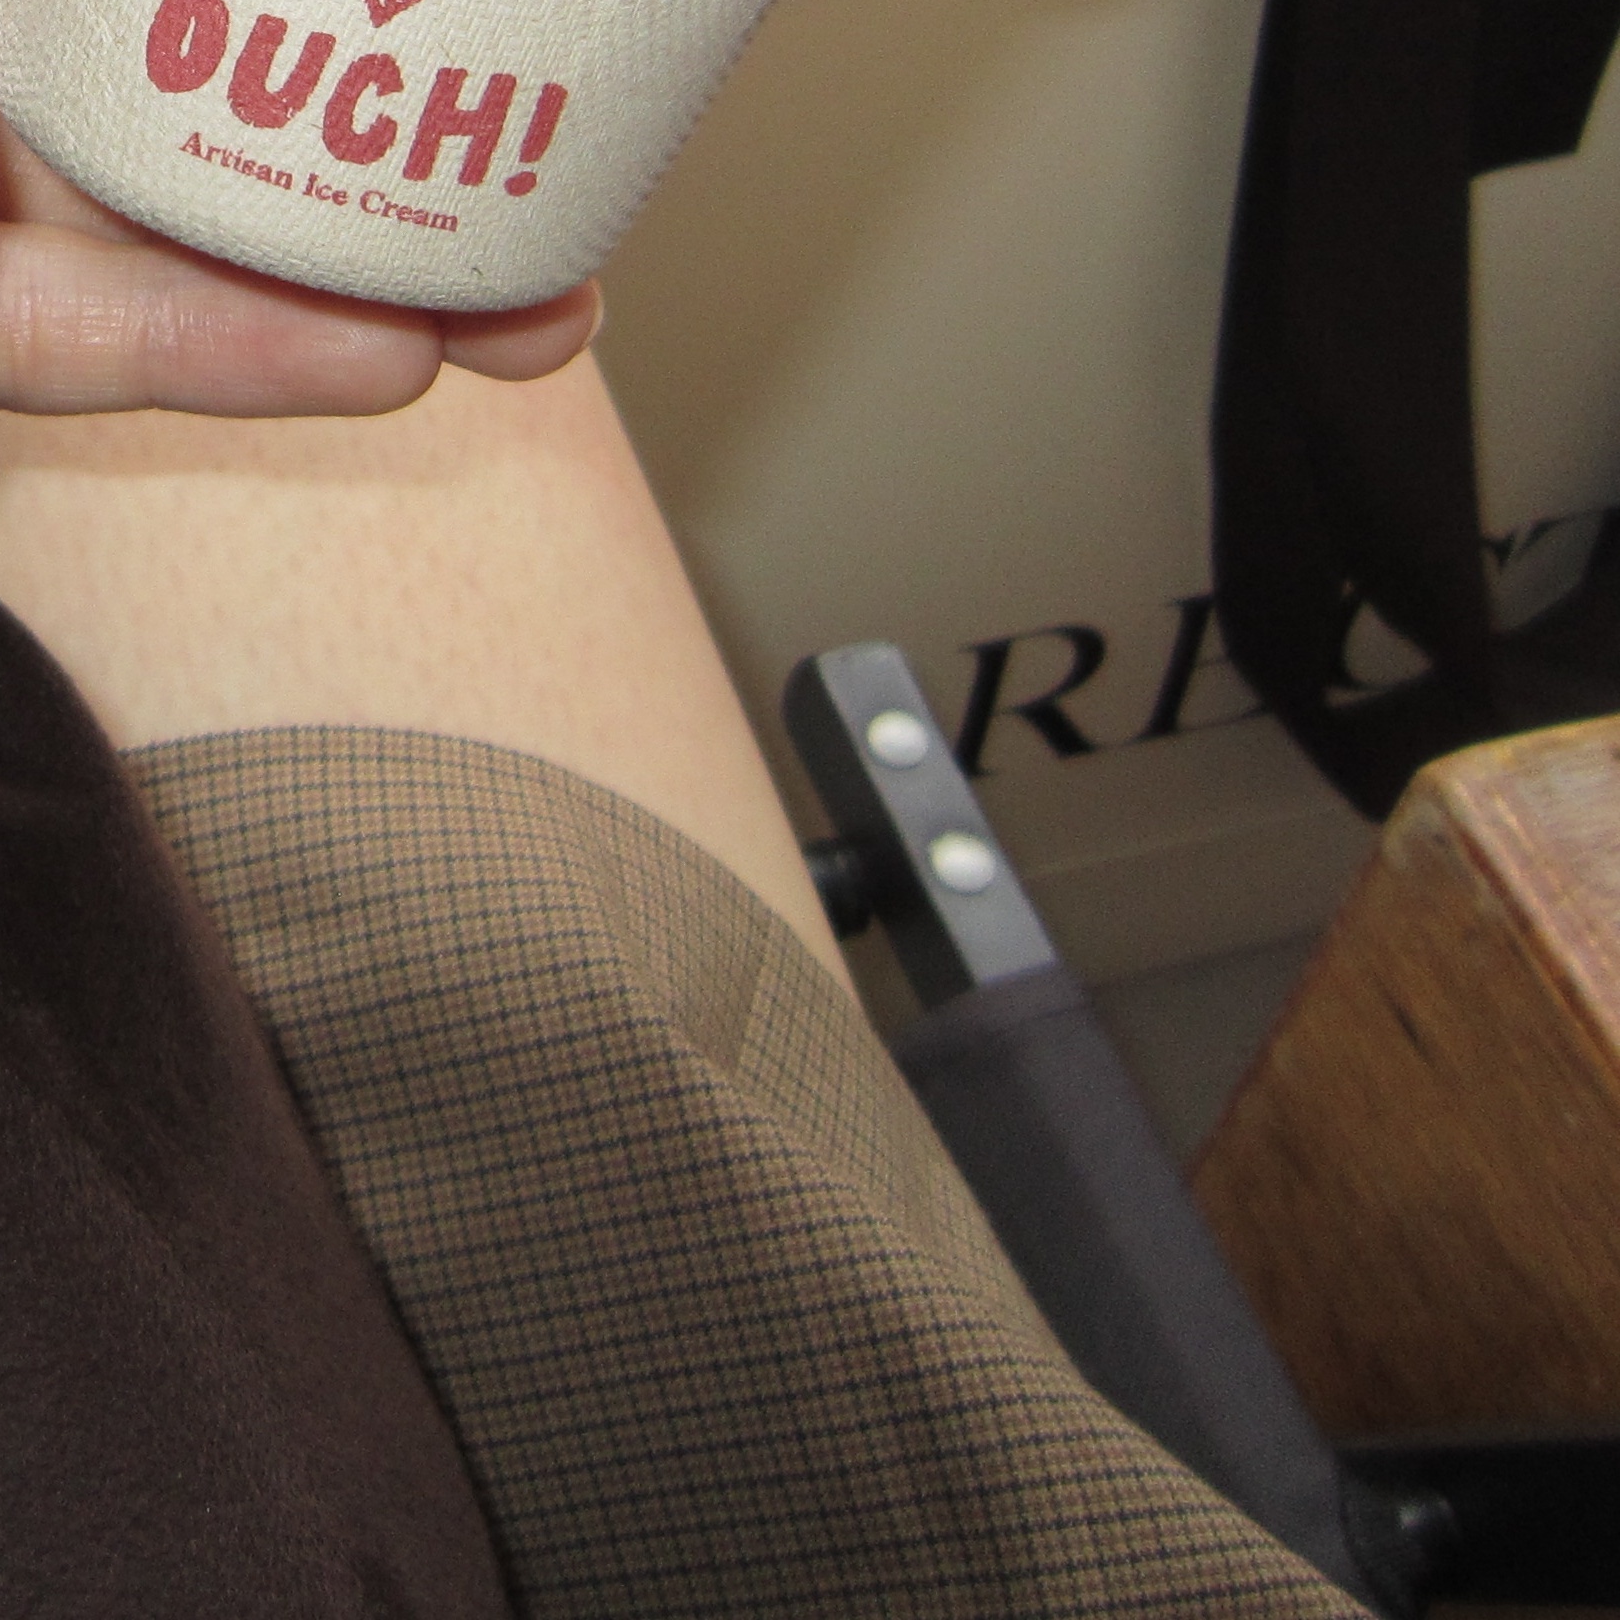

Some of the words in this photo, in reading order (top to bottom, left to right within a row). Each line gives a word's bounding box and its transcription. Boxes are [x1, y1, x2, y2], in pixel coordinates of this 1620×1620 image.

[179, 131, 294, 191] Artisan
[302, 172, 349, 206] Ice
[359, 189, 460, 232] Cream
